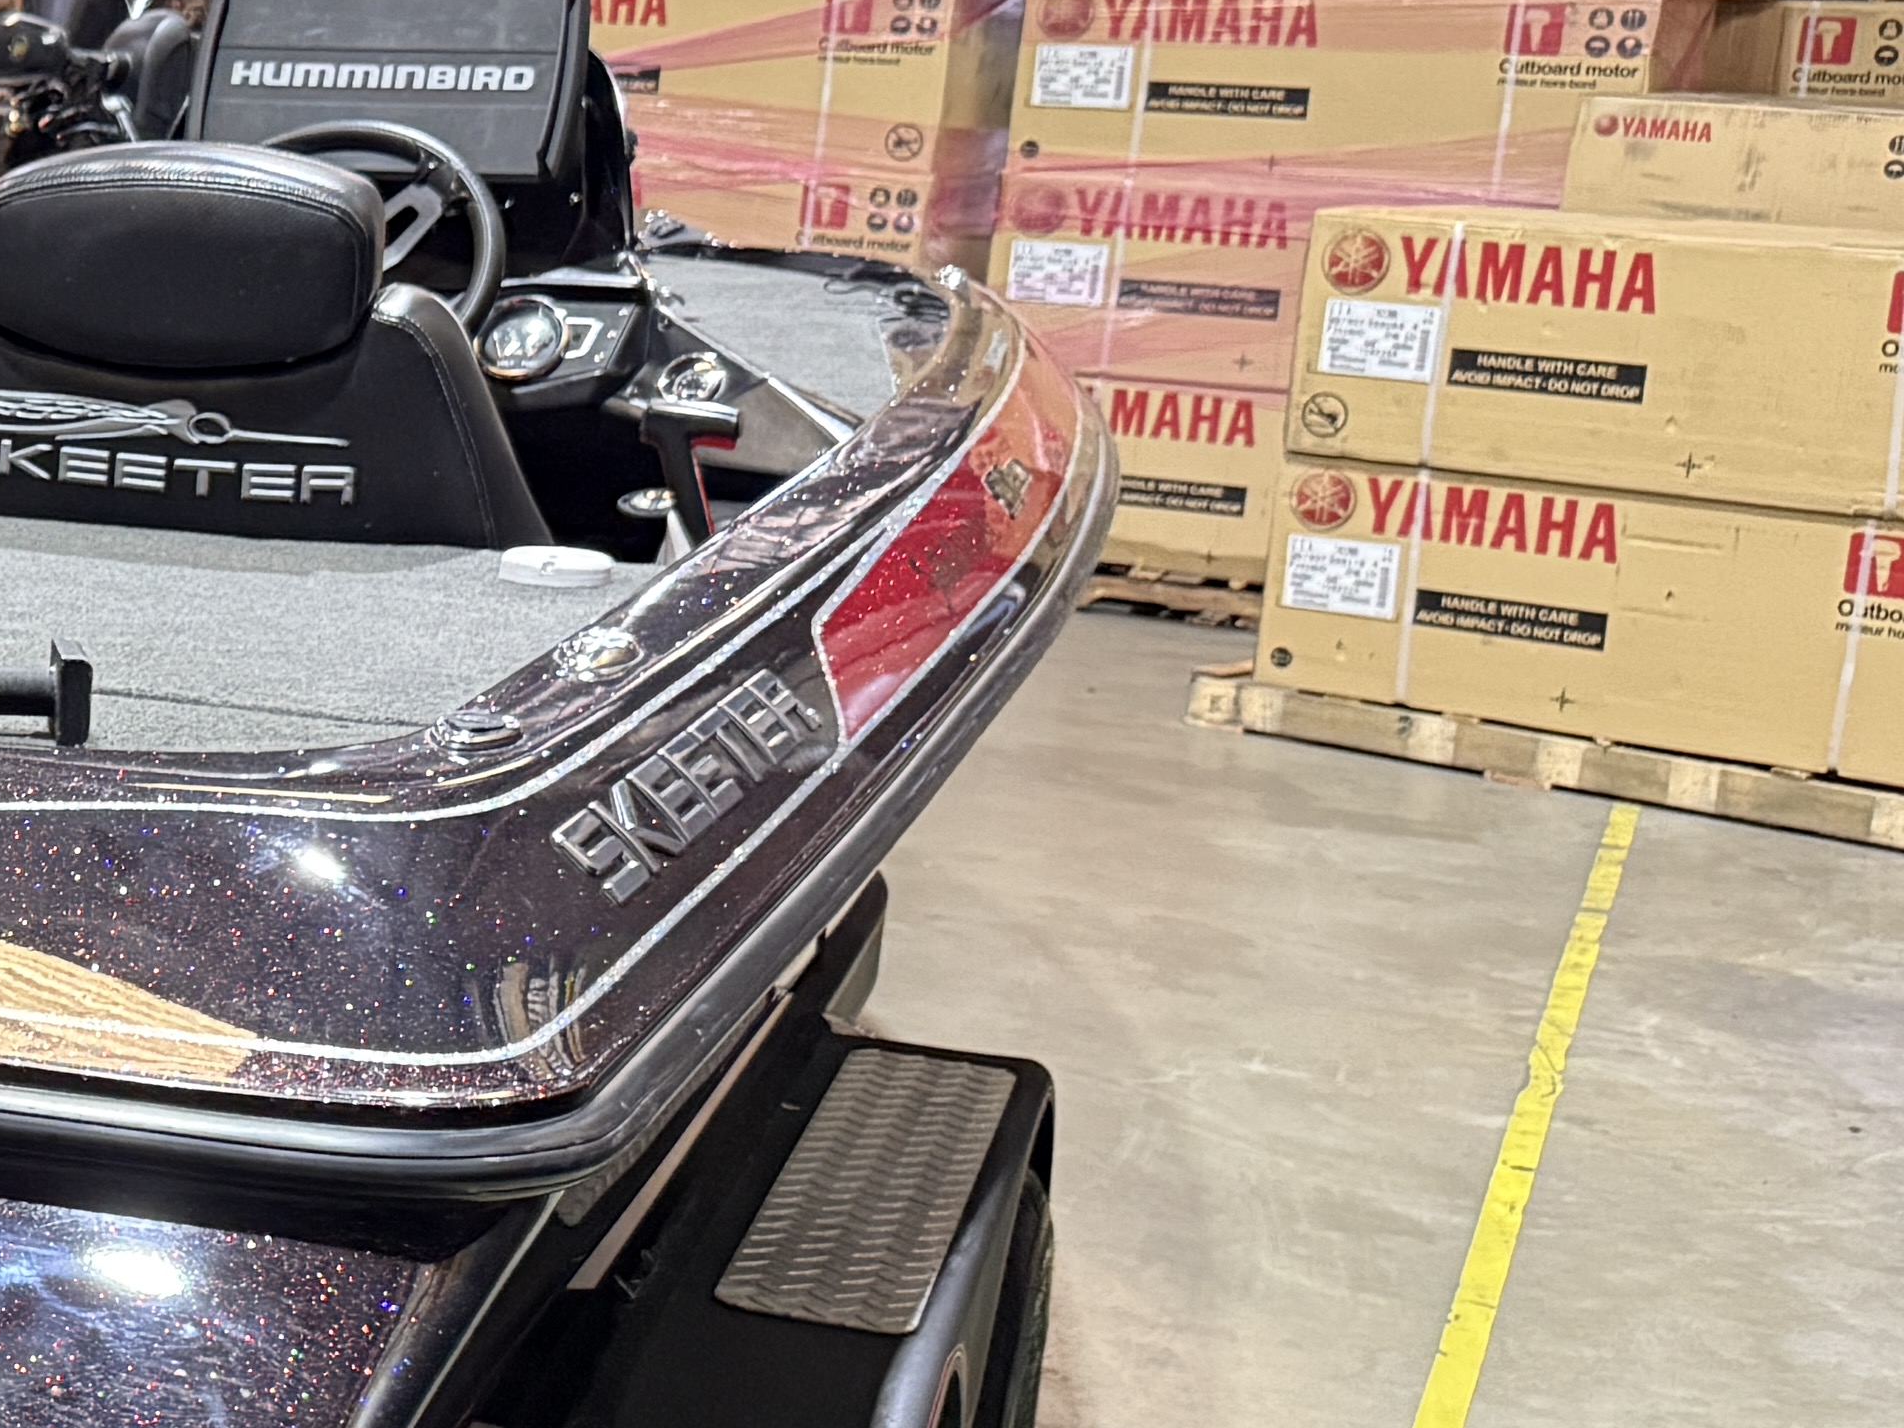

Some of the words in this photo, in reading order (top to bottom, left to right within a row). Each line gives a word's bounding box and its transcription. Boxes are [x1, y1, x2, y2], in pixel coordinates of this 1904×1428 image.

[229, 57, 537, 94] HUMMINBIRD
[1586, 63, 1640, 79] motor
[1168, 85, 1217, 98] HANDLE
[1220, 87, 1250, 99] WITH
[1252, 89, 1286, 101] CARE
[1621, 115, 1712, 143] YAMAHA
[1076, 187, 1287, 249] YAMAHA
[867, 236, 913, 252] motor
[1400, 235, 1656, 315] YAMAHA
[1477, 354, 1534, 371] HANDLE
[1538, 359, 1574, 375] WITH
[1577, 362, 1619, 379] CARE
[1451, 371, 1490, 385] AVOID
[1572, 380, 1599, 395] NOT
[1601, 383, 1640, 400] DROP
[1109, 388, 1255, 448] MAHA
[1367, 476, 1617, 564] YAMAHA
[1441, 595, 1496, 614] HANDLE
[1500, 602, 1537, 619] WITH
[1539, 607, 1579, 626] CARE
[1416, 609, 1455, 627] AVOID
[1533, 625, 1561, 641] NOT
[1563, 629, 1601, 647] DROP
[550, 668, 824, 906] SKEETER
